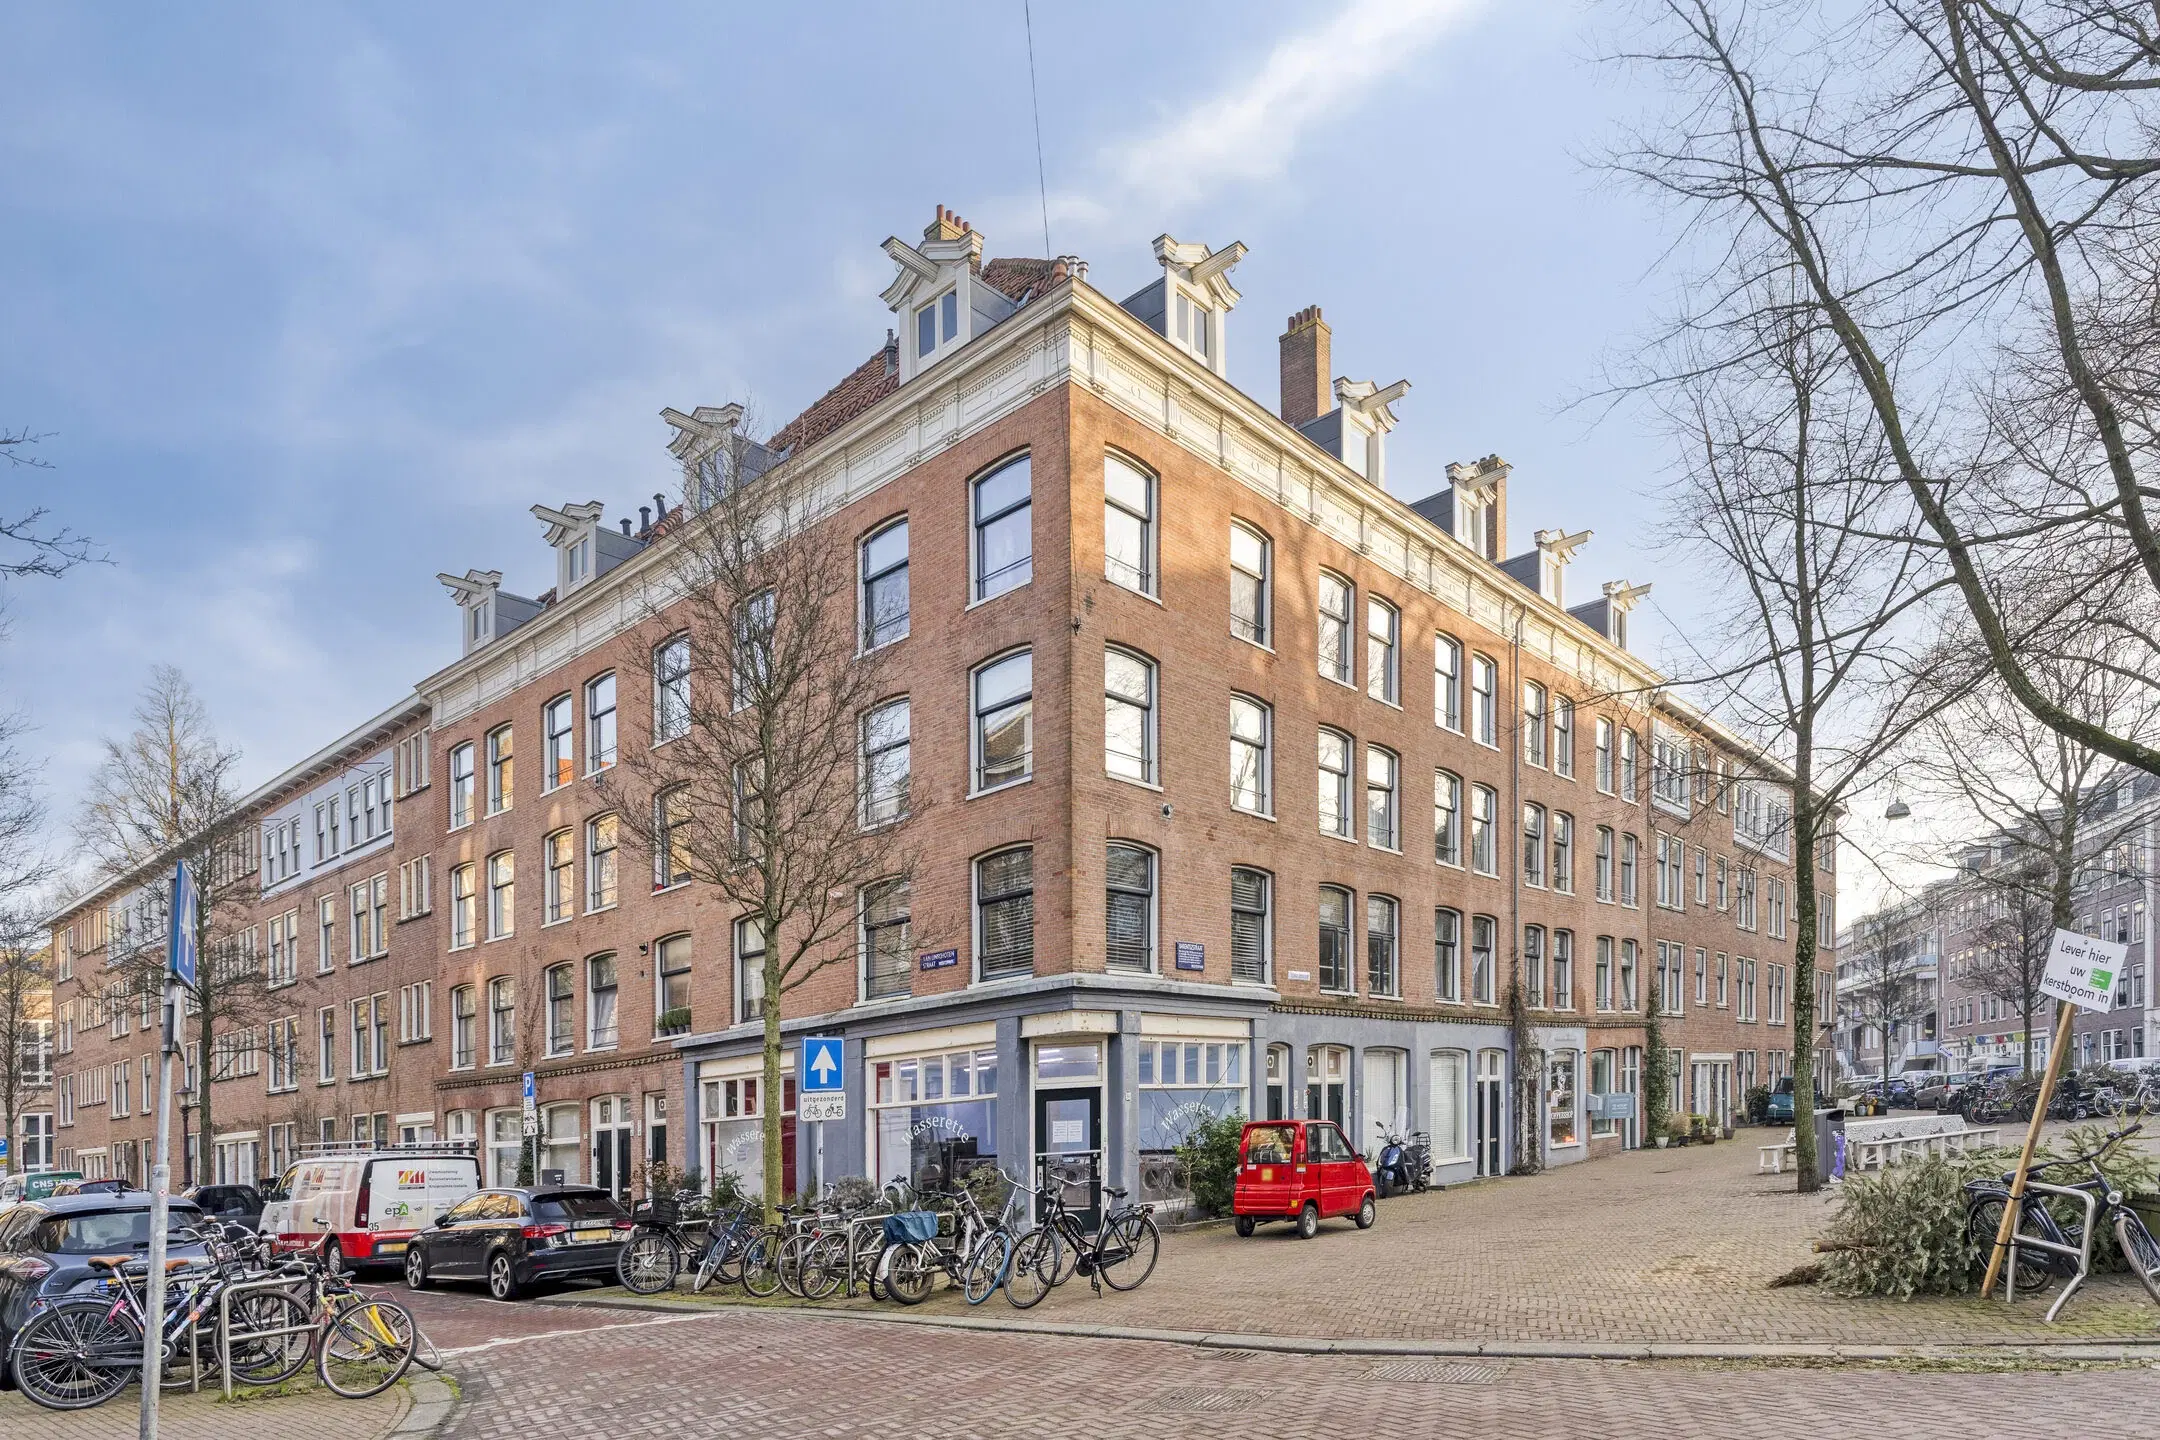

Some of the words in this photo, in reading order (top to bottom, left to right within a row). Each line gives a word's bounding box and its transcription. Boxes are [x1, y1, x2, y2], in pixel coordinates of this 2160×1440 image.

[2060, 940, 2086, 958] Lever
[2088, 948, 2112, 964] hier
[2070, 966, 2086, 977] uw
[2043, 973, 2095, 1000] kerstboom
[2098, 991, 2109, 1004] in
[525, 1076, 532, 1096] P
[368, 1222, 380, 1231] 35
